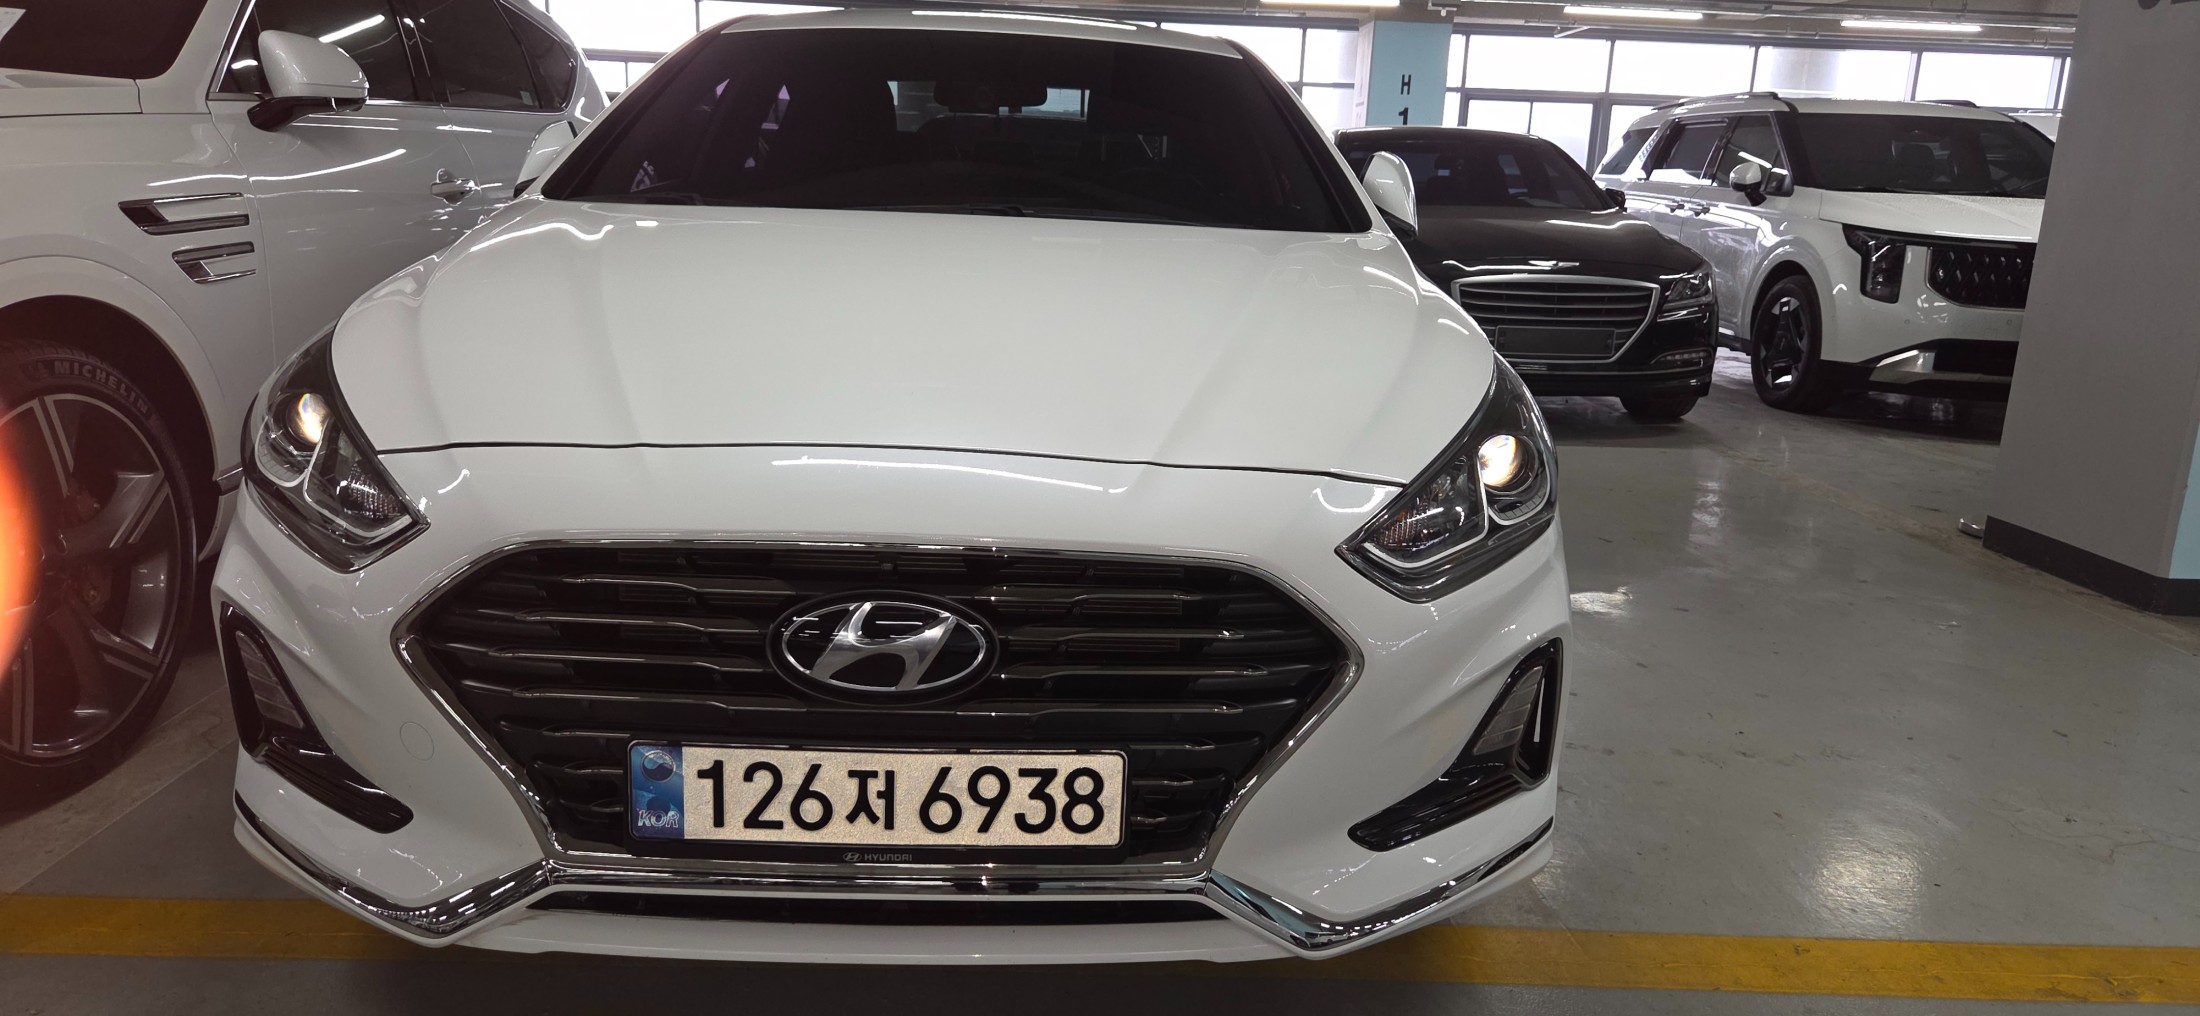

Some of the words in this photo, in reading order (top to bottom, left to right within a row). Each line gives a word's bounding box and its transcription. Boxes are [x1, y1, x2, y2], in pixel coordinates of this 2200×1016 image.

[1400, 74, 1412, 95] H
[1398, 107, 1409, 126] 1
[53, 360, 149, 415] MICHELIN
[697, 759, 895, 832] 126저
[918, 765, 1105, 835] 6938
[637, 809, 680, 828] KOR
[864, 853, 913, 862] HYUNDAI
